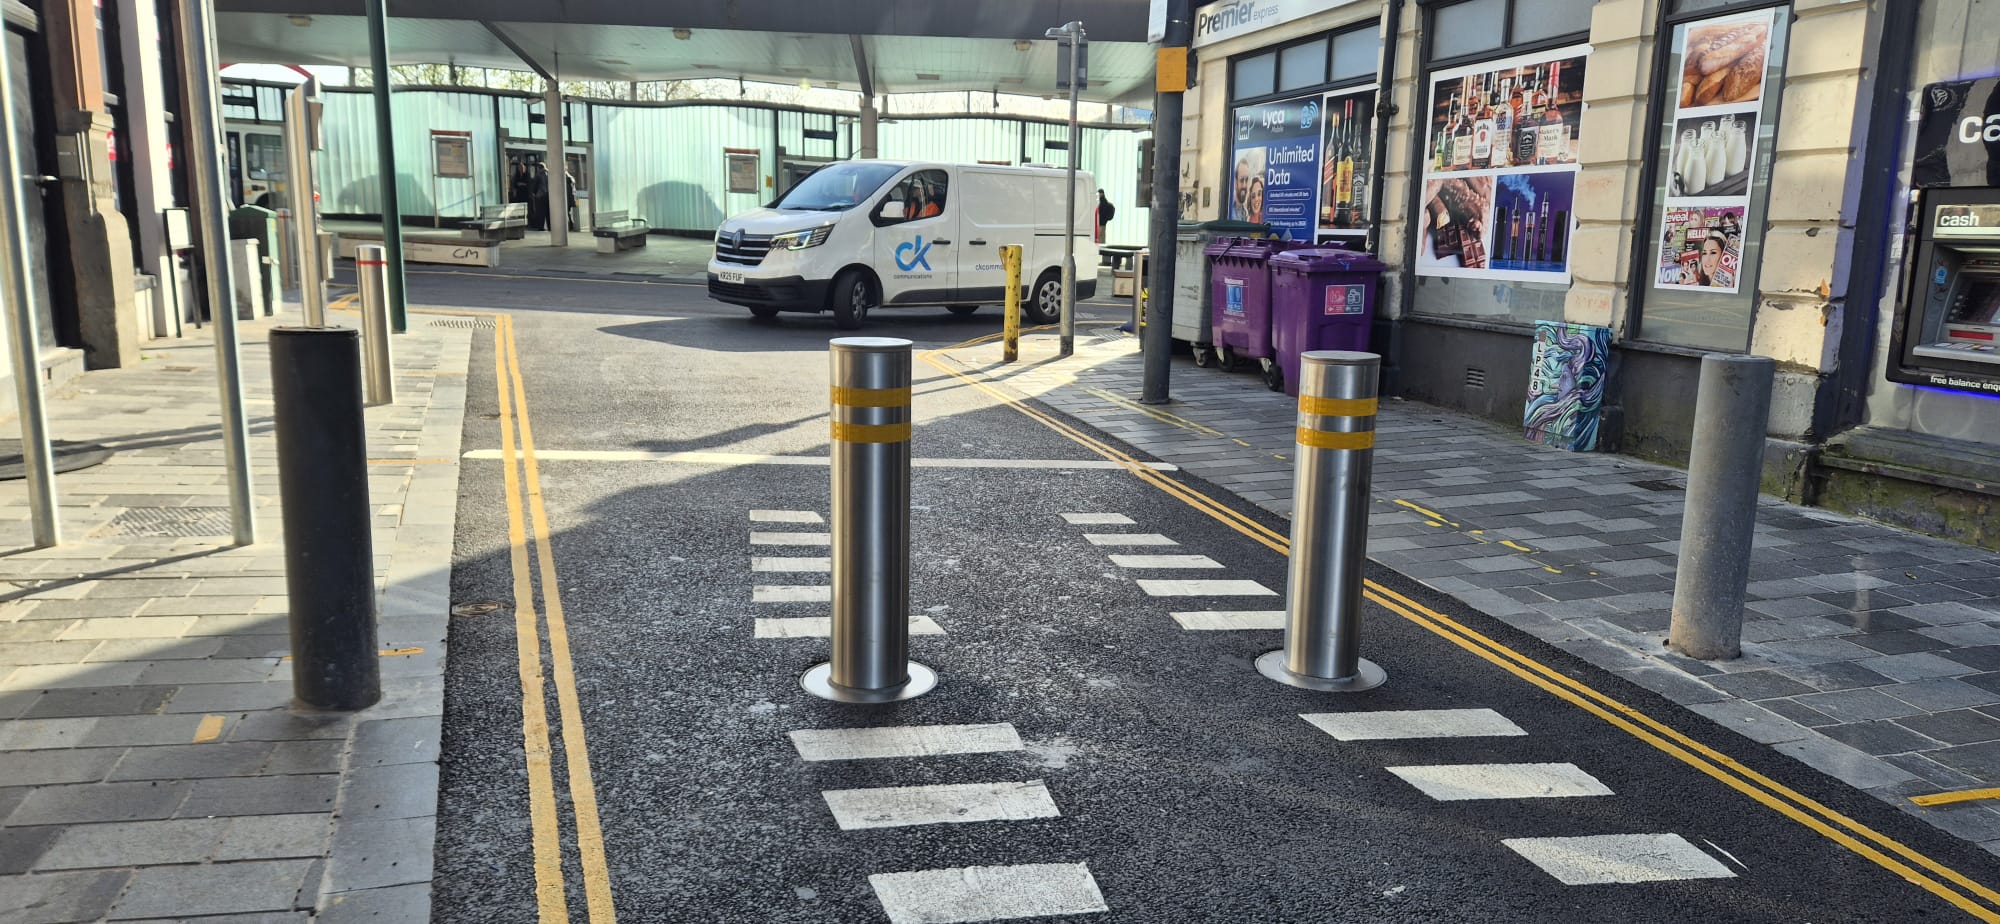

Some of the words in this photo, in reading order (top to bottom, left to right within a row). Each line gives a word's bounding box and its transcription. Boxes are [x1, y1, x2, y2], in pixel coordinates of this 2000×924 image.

[1198, 1, 1255, 37] Premier
[1254, 5, 1279, 24] express
[1262, 109, 1285, 129] Lyca
[1269, 143, 1315, 165] Unlimited
[1267, 168, 1290, 186] Data
[1940, 211, 1980, 227] cash
[453, 248, 479, 259] CM
[1930, 375, 1947, 385] free
[1948, 377, 1981, 389] balance
[1982, 382, 2000, 393] enq
